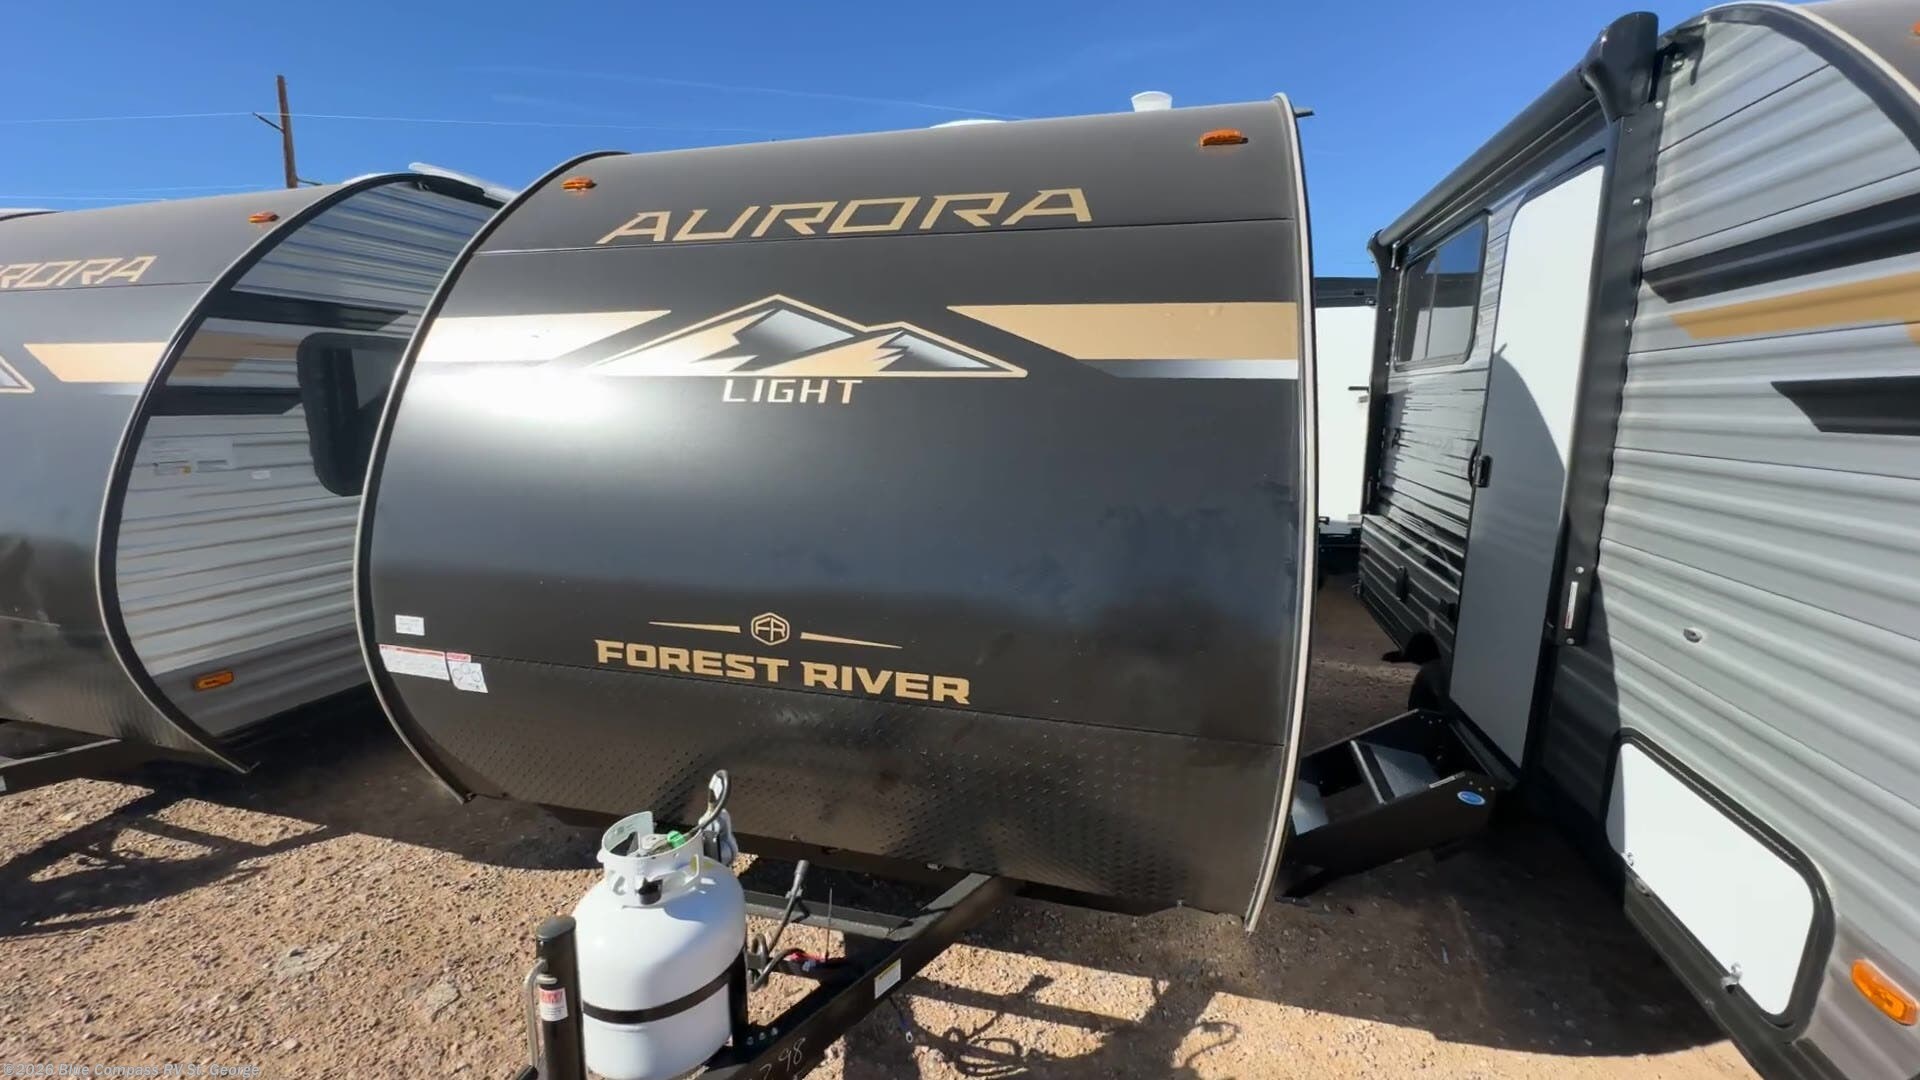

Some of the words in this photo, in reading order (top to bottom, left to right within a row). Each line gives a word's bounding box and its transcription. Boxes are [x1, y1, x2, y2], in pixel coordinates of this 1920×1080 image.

[595, 187, 1093, 244] AURORA
[0, 255, 157, 288] RORA
[722, 378, 863, 404] LIGHT
[594, 639, 790, 683] FOREST
[800, 661, 970, 705] RIVER
